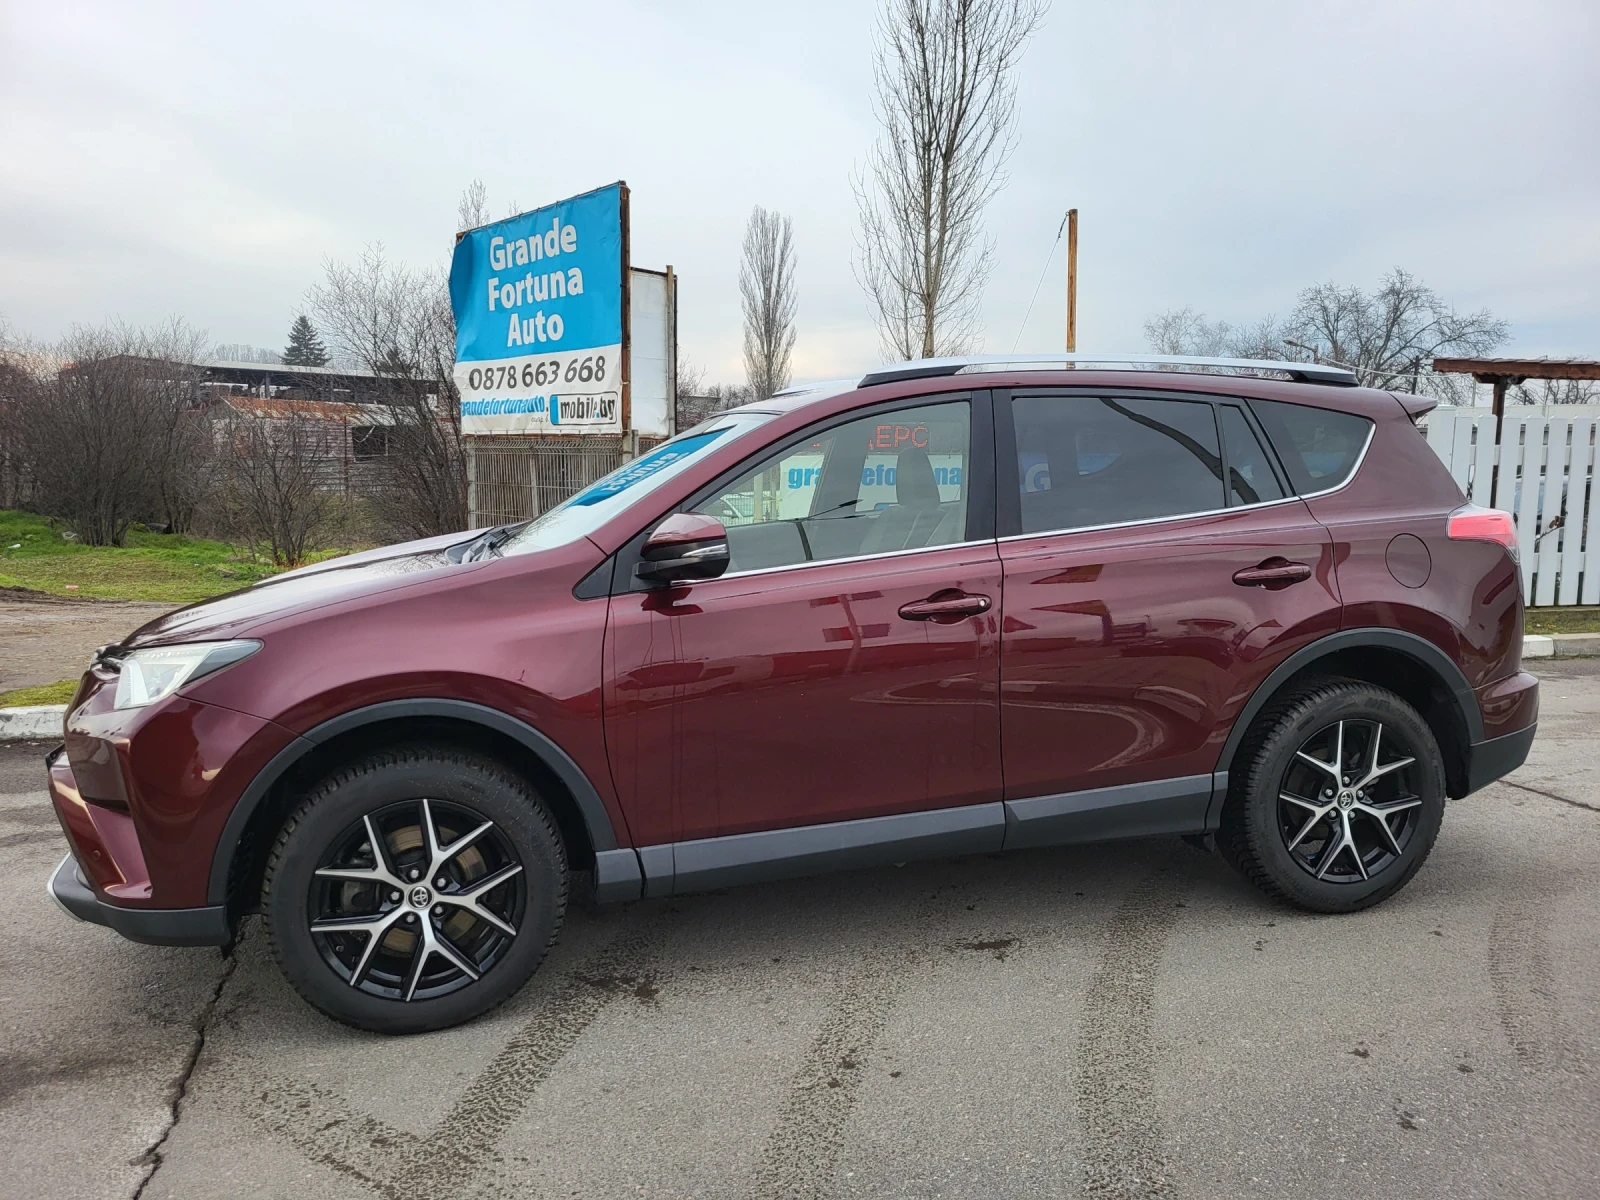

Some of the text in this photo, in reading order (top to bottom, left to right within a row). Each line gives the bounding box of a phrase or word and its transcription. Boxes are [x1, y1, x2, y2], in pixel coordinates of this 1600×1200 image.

[490, 218, 577, 271] Grande
[487, 267, 583, 311] Fortuna
[507, 310, 564, 347] Auto
[469, 355, 606, 391] 0878 663 668
[560, 396, 616, 421] mobile.bg
